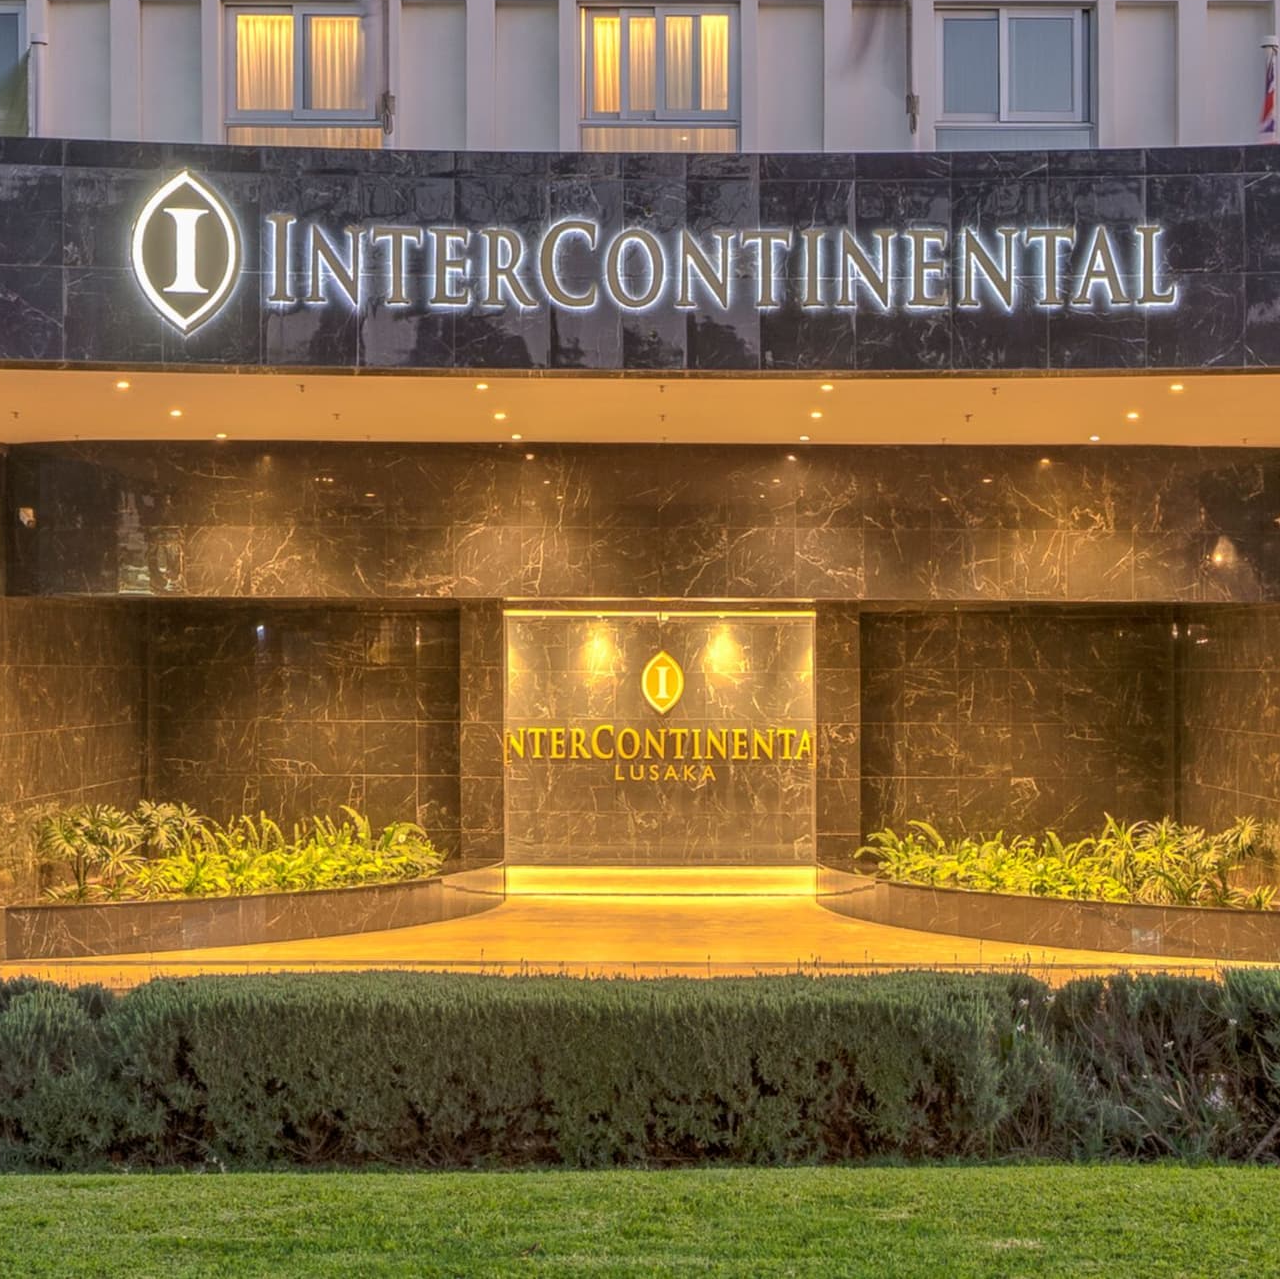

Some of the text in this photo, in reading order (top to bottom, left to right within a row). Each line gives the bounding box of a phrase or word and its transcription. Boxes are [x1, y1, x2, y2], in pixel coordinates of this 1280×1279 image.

[162, 207, 210, 294] I
[655, 665, 671, 699] I
[508, 724, 811, 760] NTERCONTINENTA
[614, 764, 716, 782] LUSAKA
